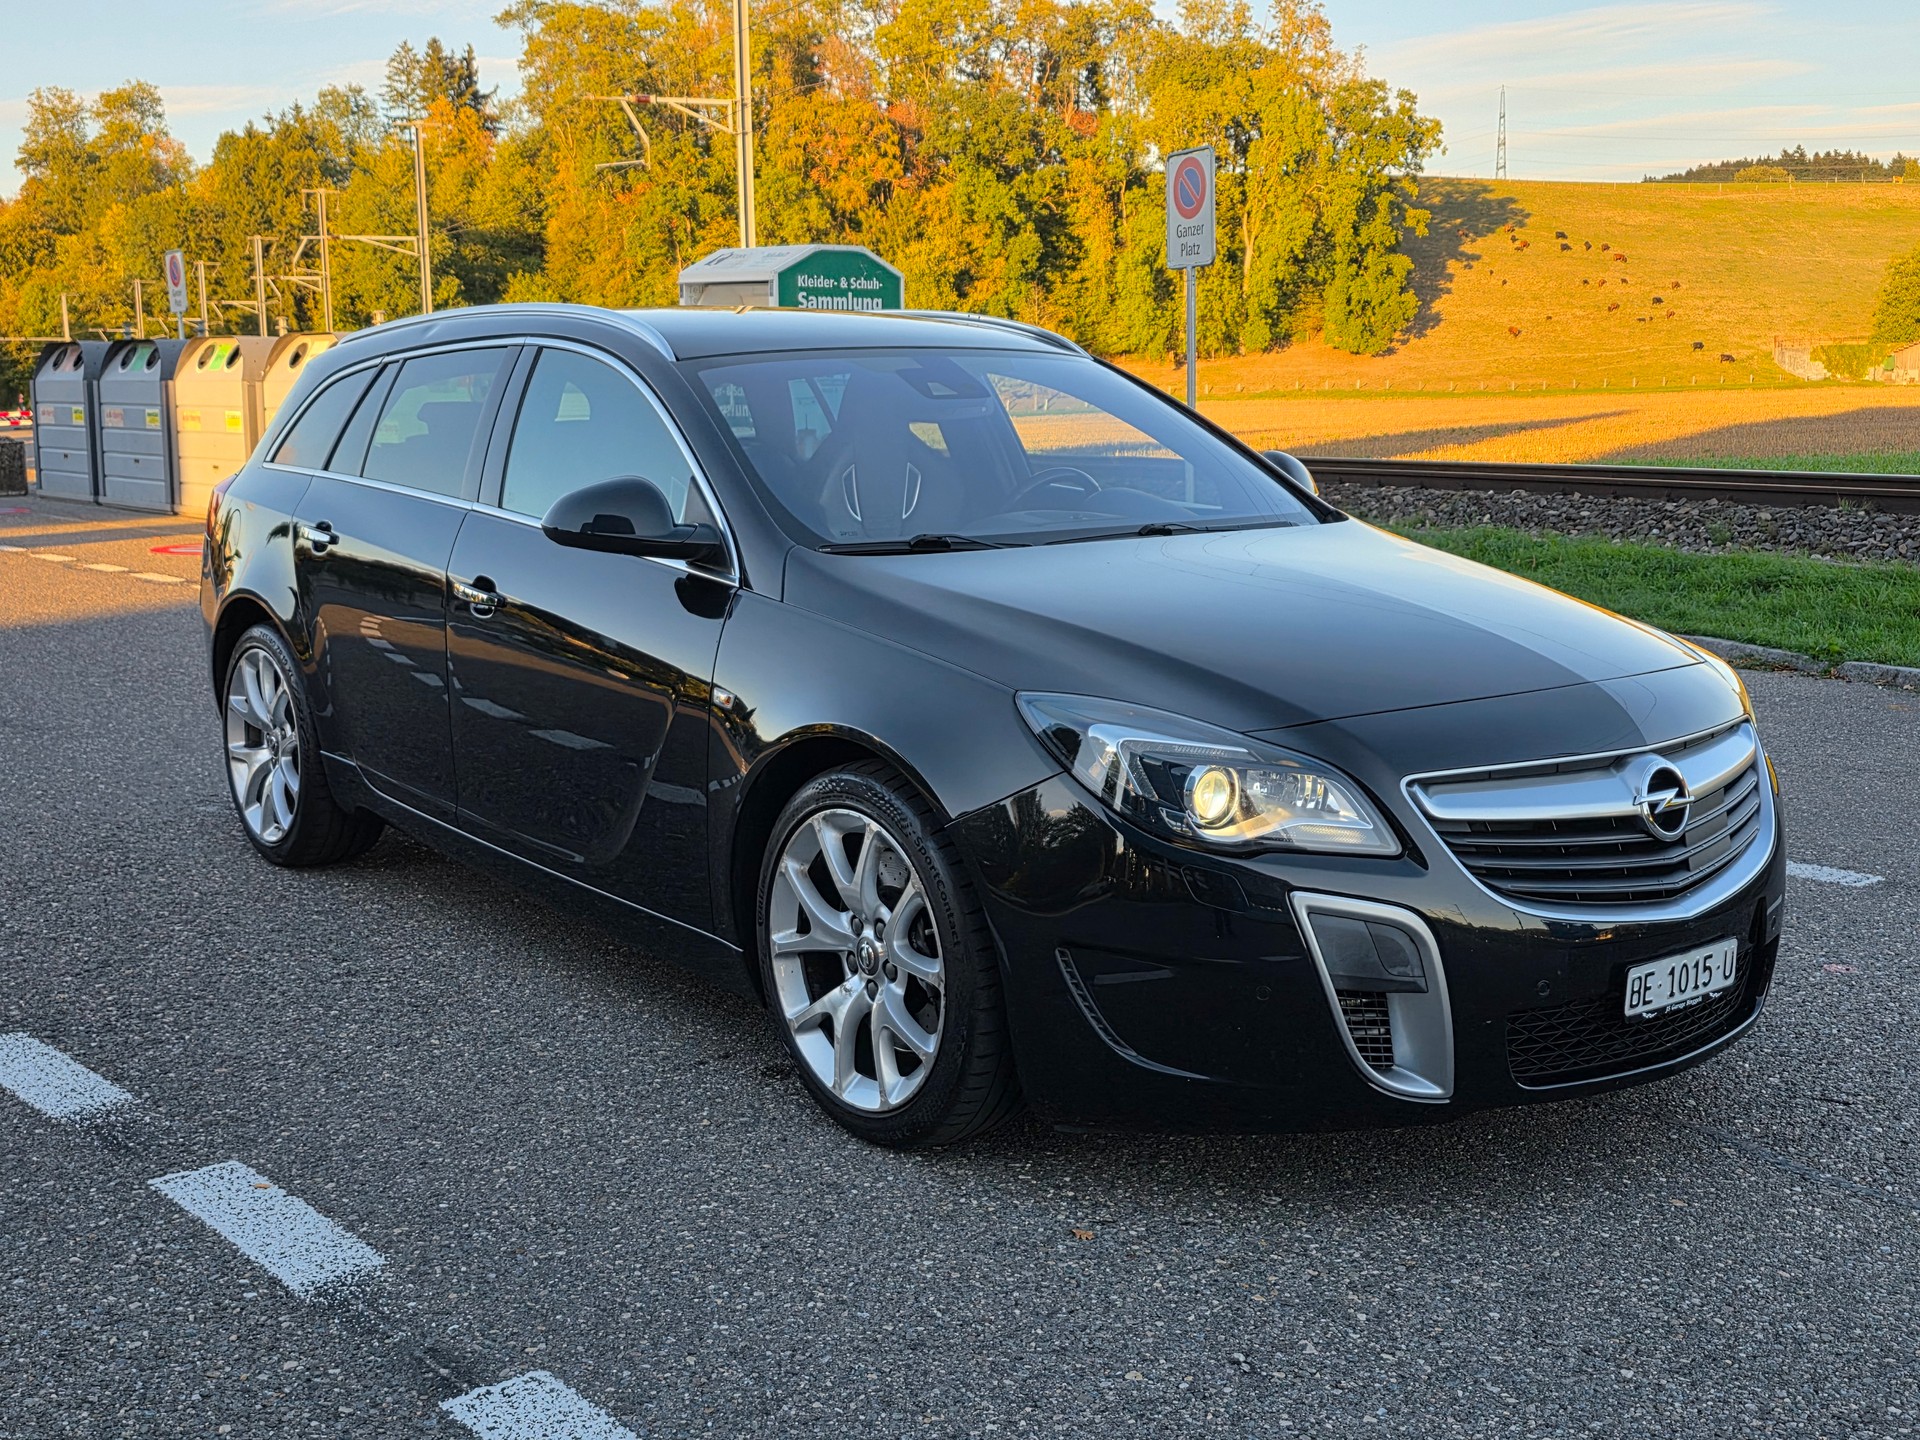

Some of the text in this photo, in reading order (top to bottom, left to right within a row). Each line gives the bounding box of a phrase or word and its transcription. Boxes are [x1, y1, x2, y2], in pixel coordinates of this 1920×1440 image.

[1176, 223, 1205, 239] Ganzer
[1180, 242, 1201, 257] Platz
[798, 275, 883, 290] Kleider- & Schuh-
[798, 291, 883, 311] Sammlung
[914, 836, 960, 947] SportContact
